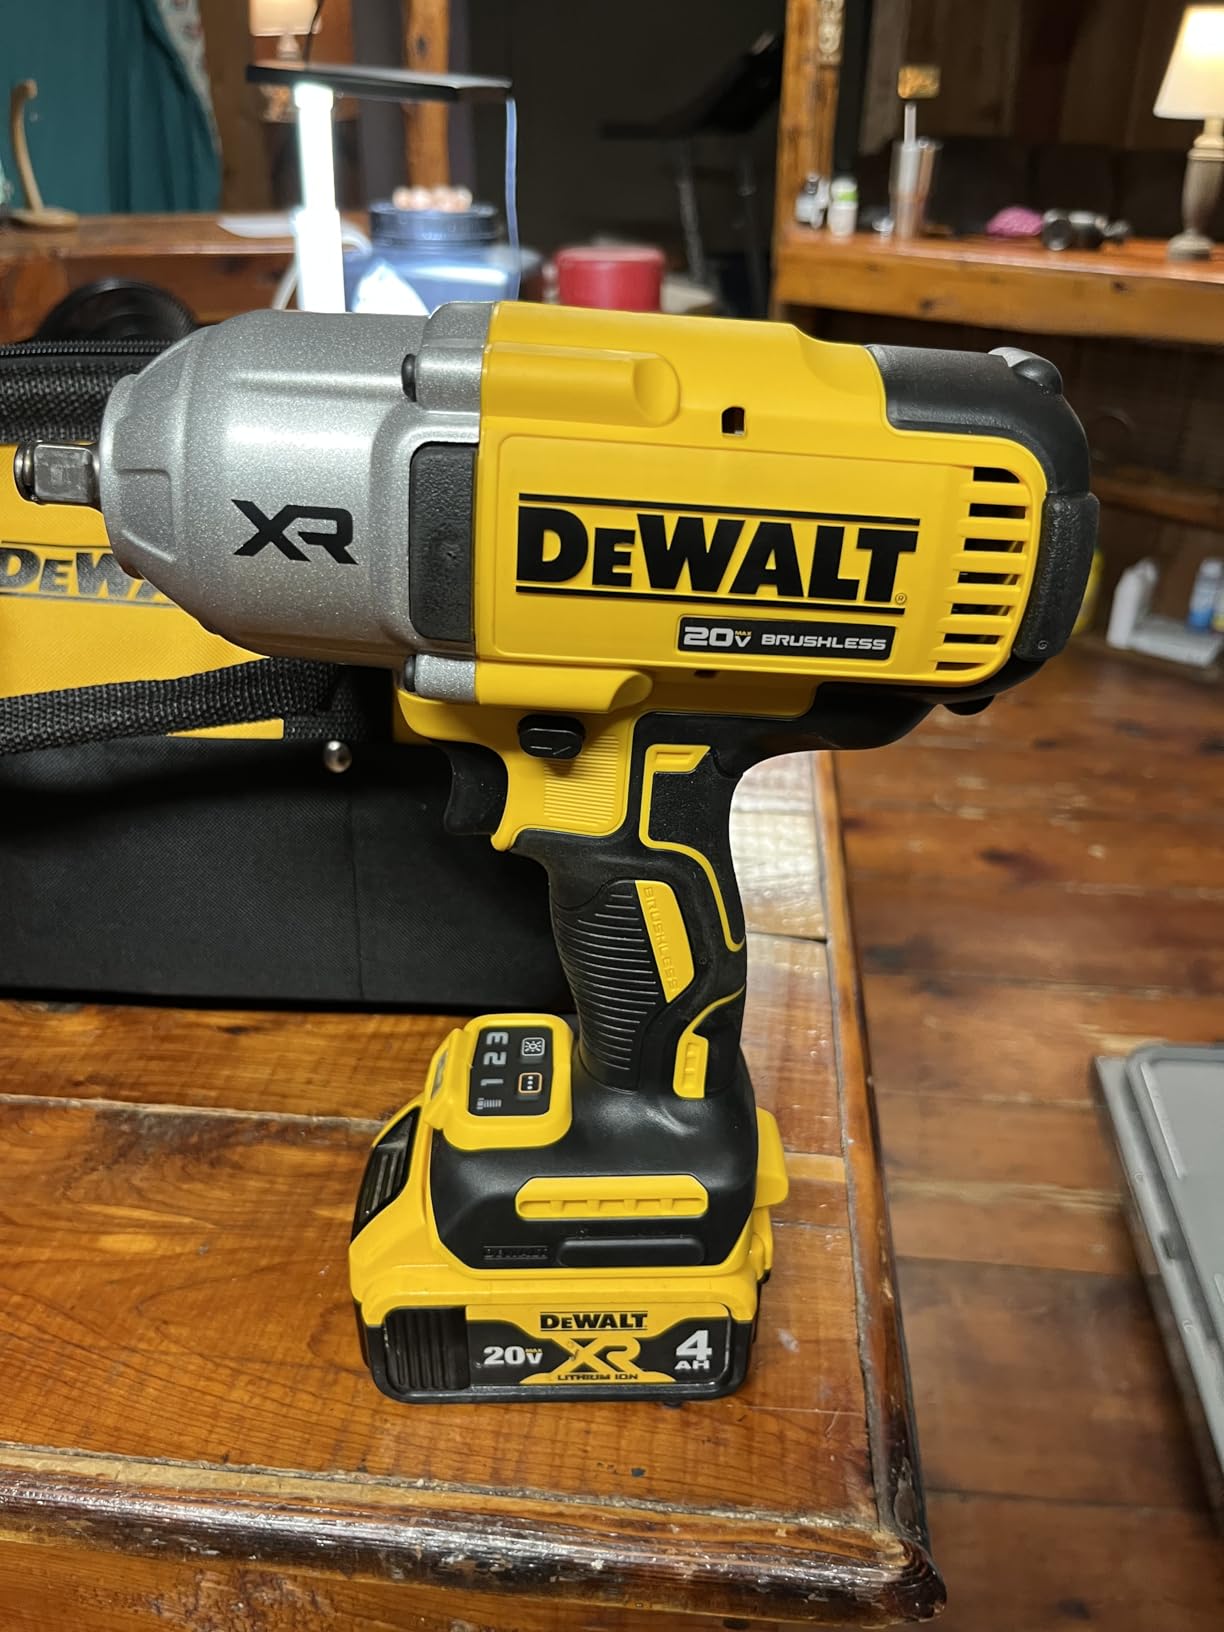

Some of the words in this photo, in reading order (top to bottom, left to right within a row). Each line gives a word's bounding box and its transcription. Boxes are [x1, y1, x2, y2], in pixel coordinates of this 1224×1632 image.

[231, 499, 358, 564] XR
[516, 506, 918, 603] DEWALT
[683, 626, 752, 647] 20V
[761, 633, 887, 651] BRUSHLESS
[643, 886, 679, 991] BRUSHLESS
[486, 1032, 509, 1045] 3
[483, 1052, 507, 1065] 2
[480, 1078, 504, 1086] 1
[540, 1313, 647, 1329] DEWALT
[483, 1346, 543, 1365] 20V
[550, 1336, 645, 1373] XR
[676, 1330, 712, 1360] 4
[674, 1360, 710, 1370] AH
